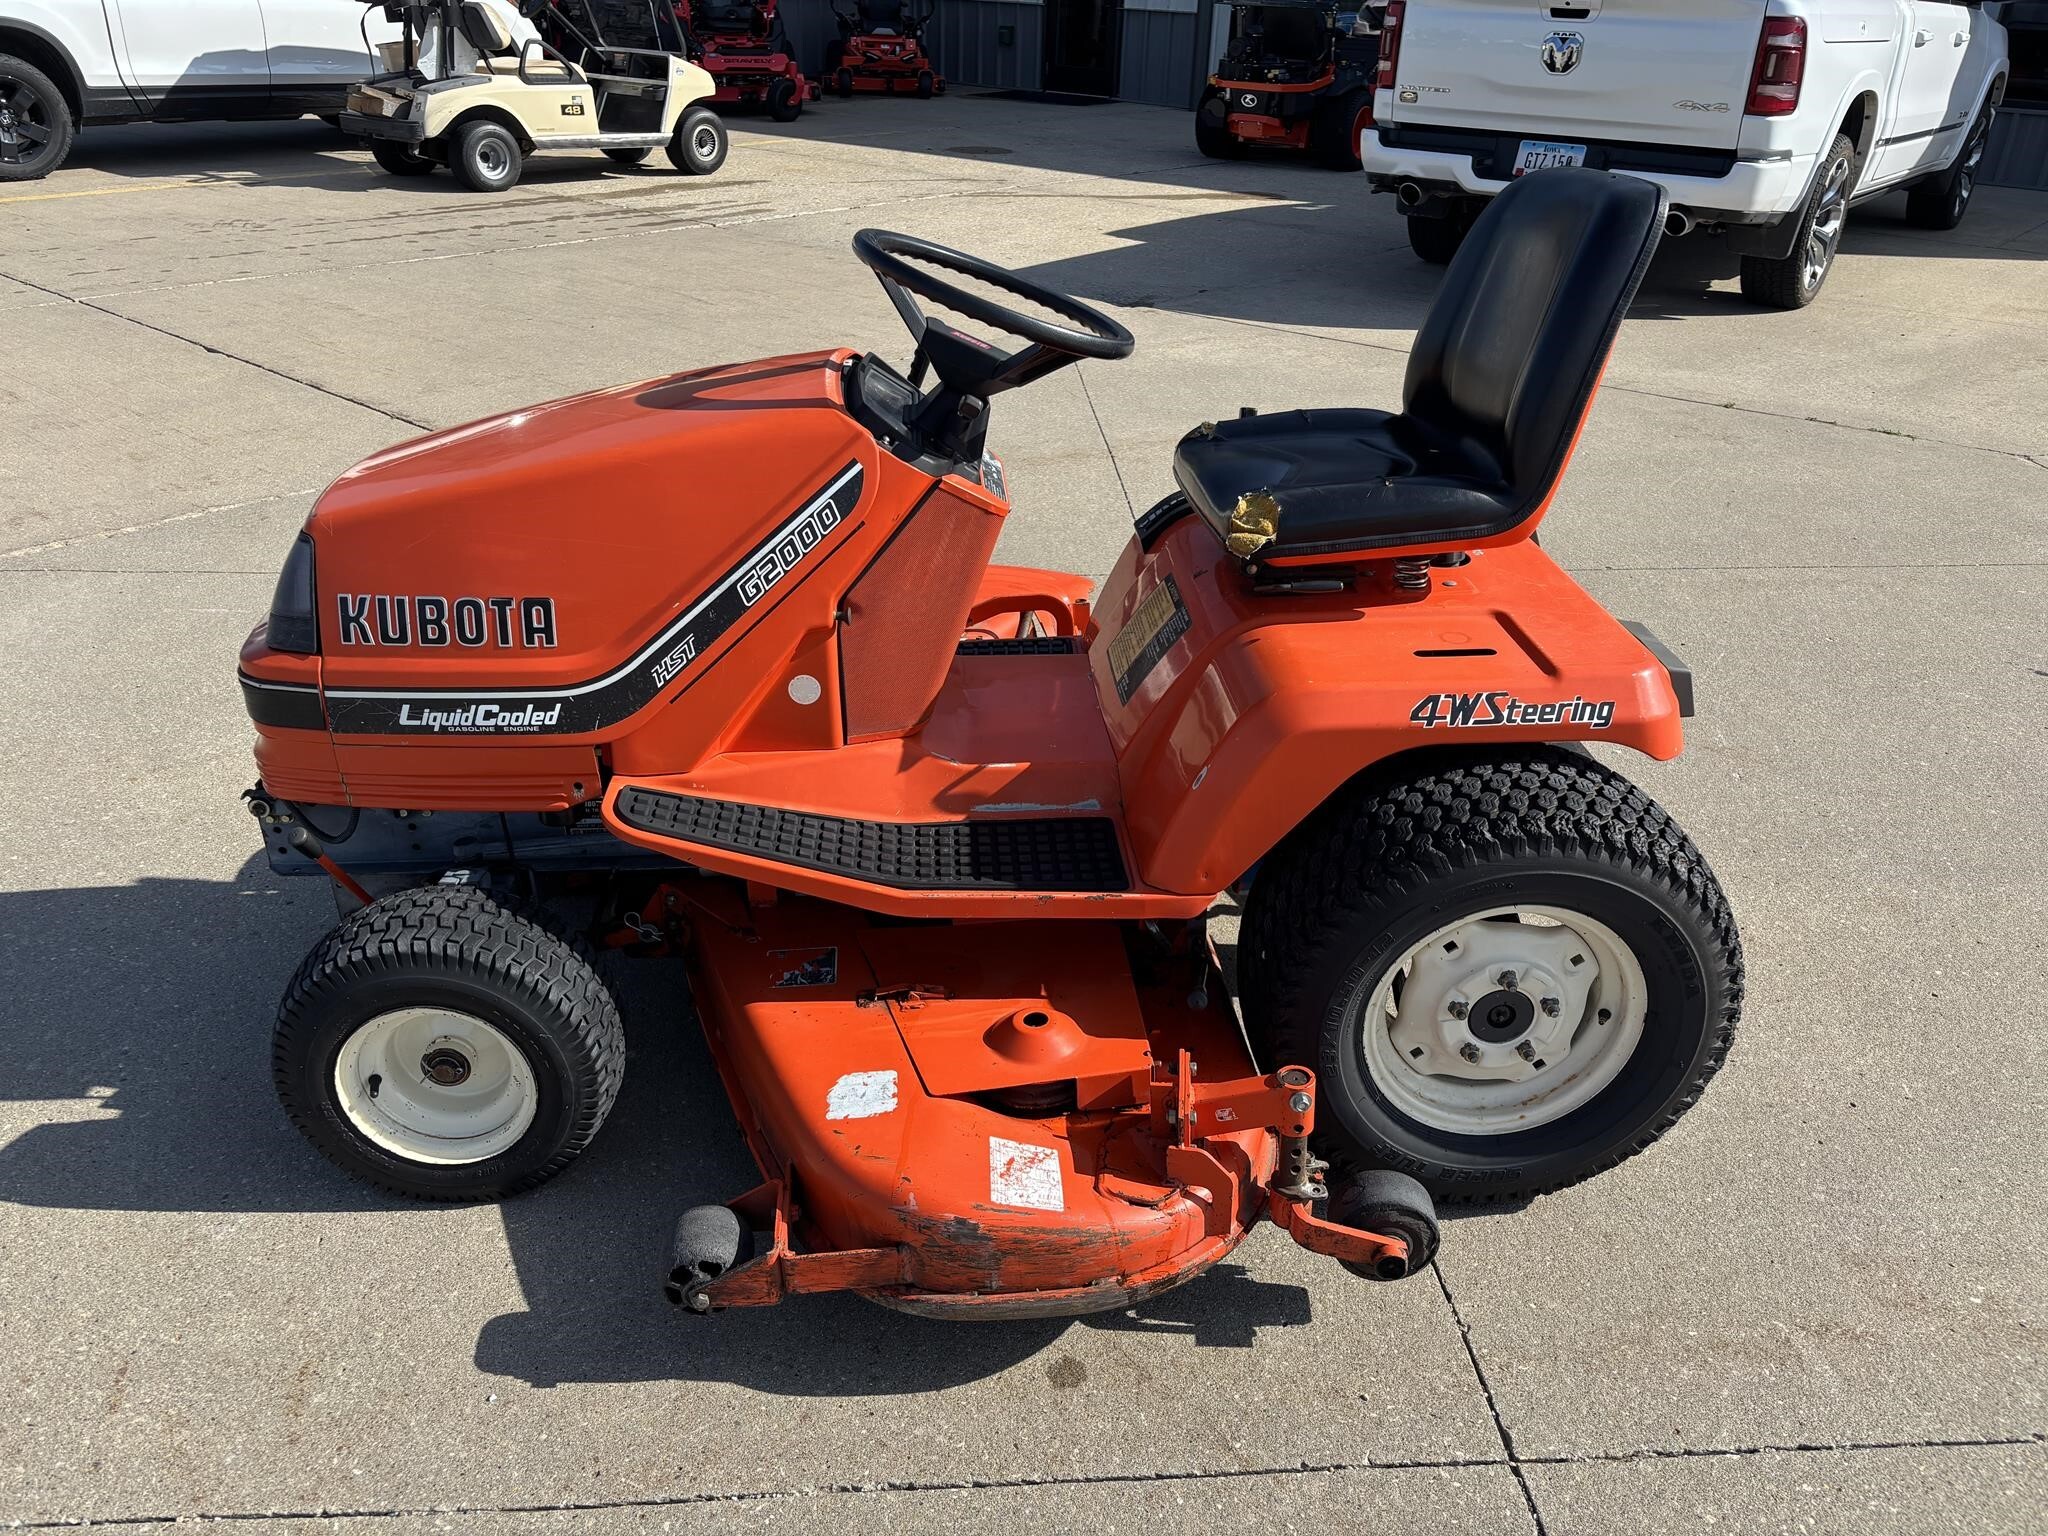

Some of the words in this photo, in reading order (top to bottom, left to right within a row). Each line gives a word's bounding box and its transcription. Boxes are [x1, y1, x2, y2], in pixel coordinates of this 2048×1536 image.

[564, 105, 581, 115] 48
[1524, 152, 1548, 169] GTZ
[736, 498, 841, 607] G2000
[337, 593, 558, 647] KUBOTA
[651, 633, 695, 688] HST
[1409, 690, 1616, 729] 4WSteering
[1369, 1141, 1430, 1175] TURF
[1438, 1166, 1523, 1184] SUPER
